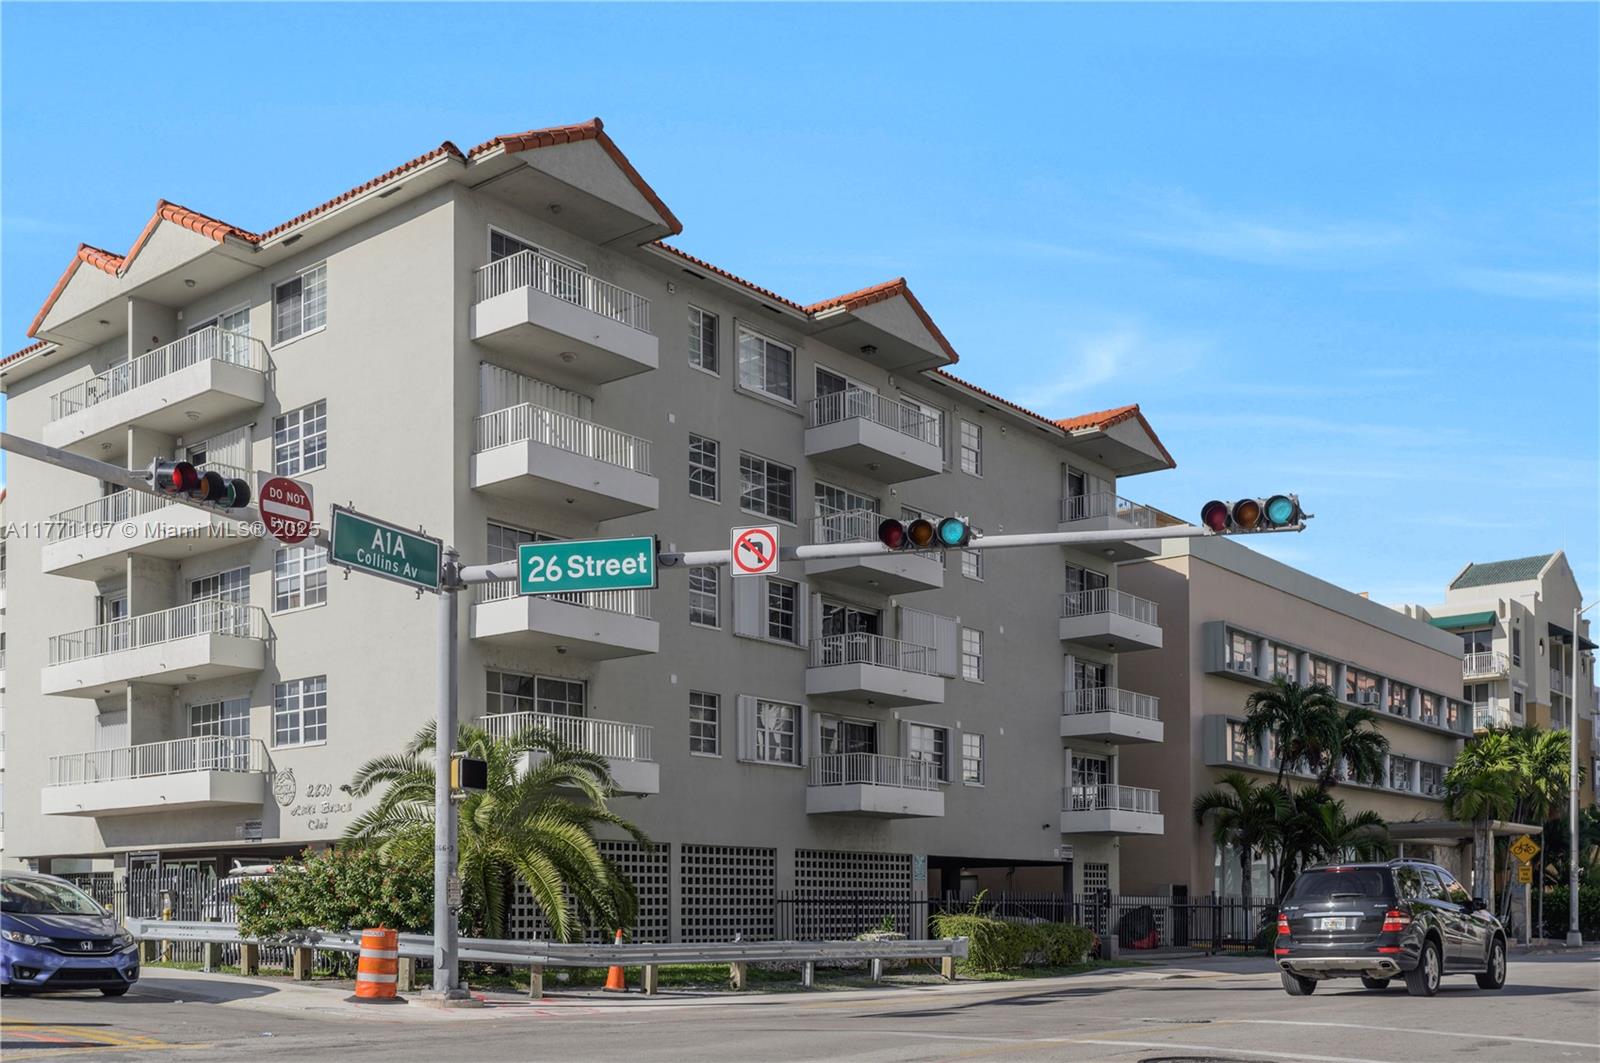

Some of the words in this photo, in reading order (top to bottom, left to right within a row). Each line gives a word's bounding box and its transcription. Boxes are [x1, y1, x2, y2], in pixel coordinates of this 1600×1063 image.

[269, 487, 283, 500] DO
[286, 491, 306, 506] NOT
[371, 528, 406, 559] A1A
[357, 548, 399, 573] Collins
[403, 562, 418, 579] Av
[528, 554, 563, 583] 26
[567, 552, 648, 579] Street
